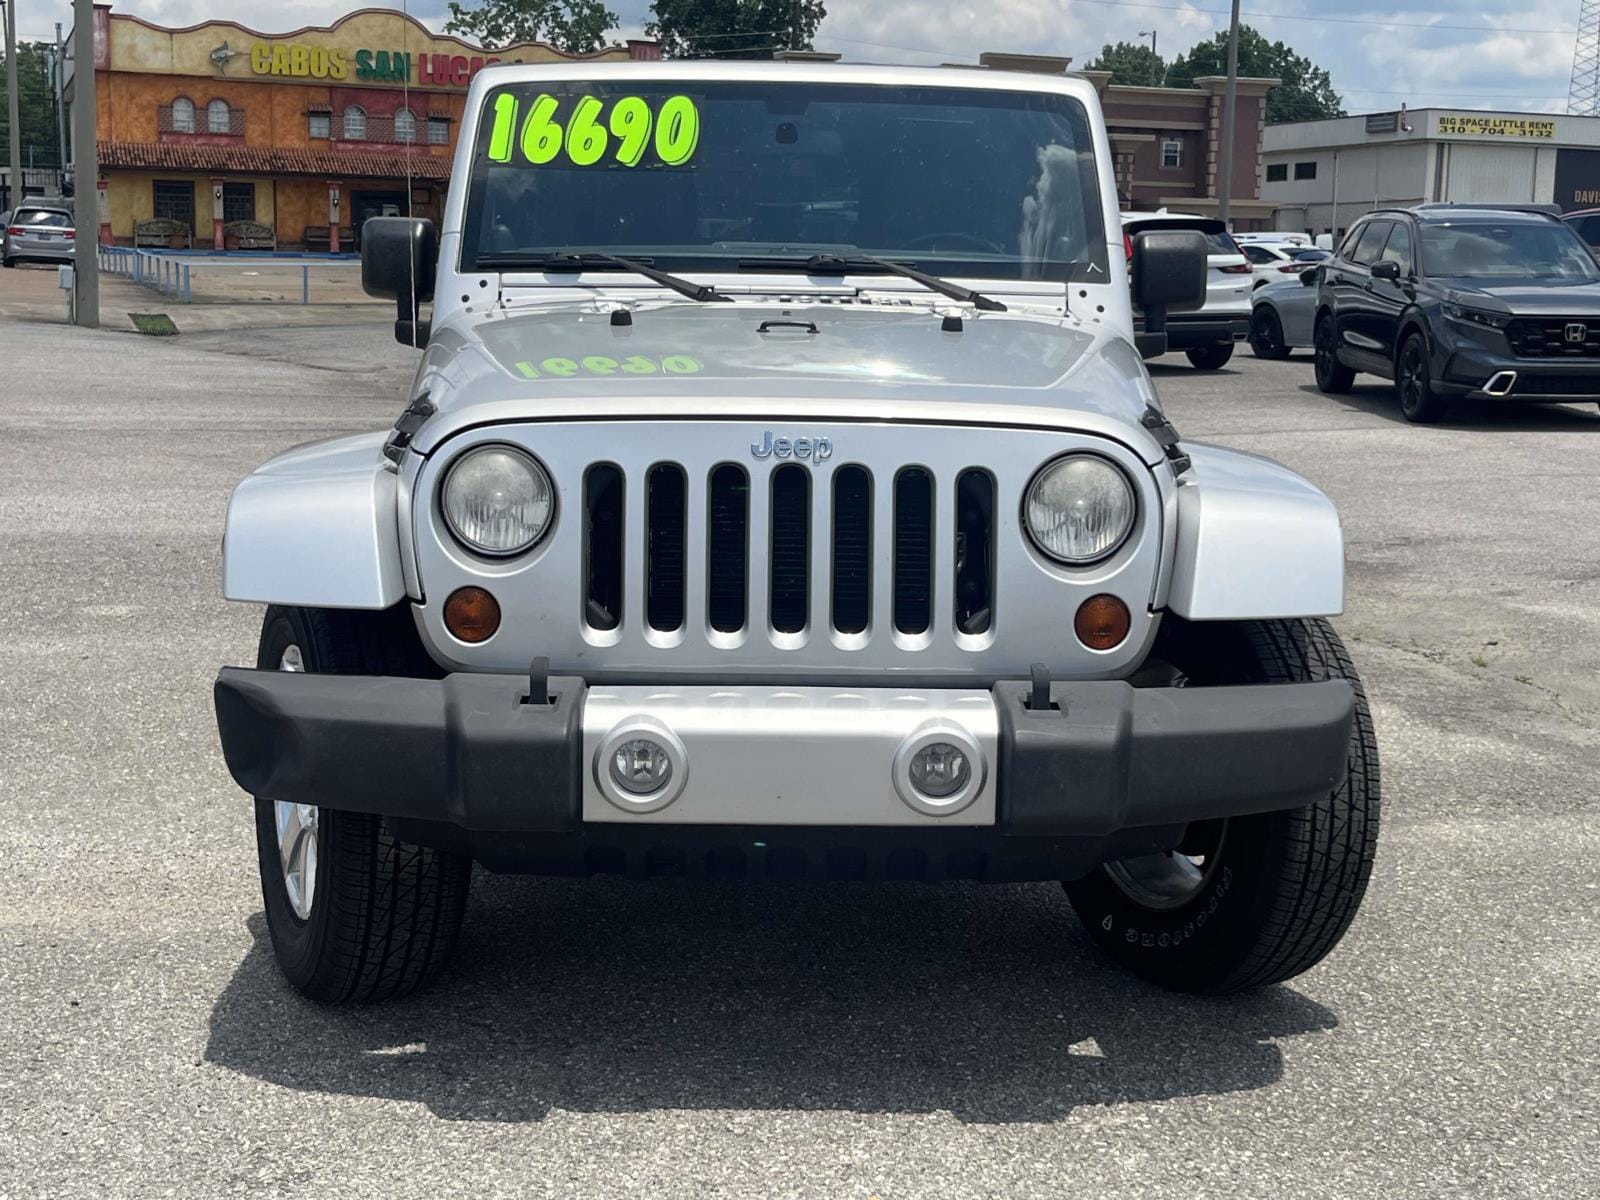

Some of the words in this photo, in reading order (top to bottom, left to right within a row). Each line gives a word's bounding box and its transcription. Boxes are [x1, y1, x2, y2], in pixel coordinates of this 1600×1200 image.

[250, 42, 348, 80] CABOS
[355, 49, 412, 83] SAN
[418, 53, 502, 86] LUCA
[488, 93, 700, 167] 16690
[1439, 117, 1457, 126] BIG
[1459, 118, 1490, 127] SPACE
[1493, 120, 1525, 129] LITTLE
[1528, 121, 1554, 130] RENT
[1479, 127, 1505, 135] 704
[1518, 129, 1553, 138] 3132
[1574, 190, 1600, 204] DAVI
[750, 429, 834, 464] Jeep
